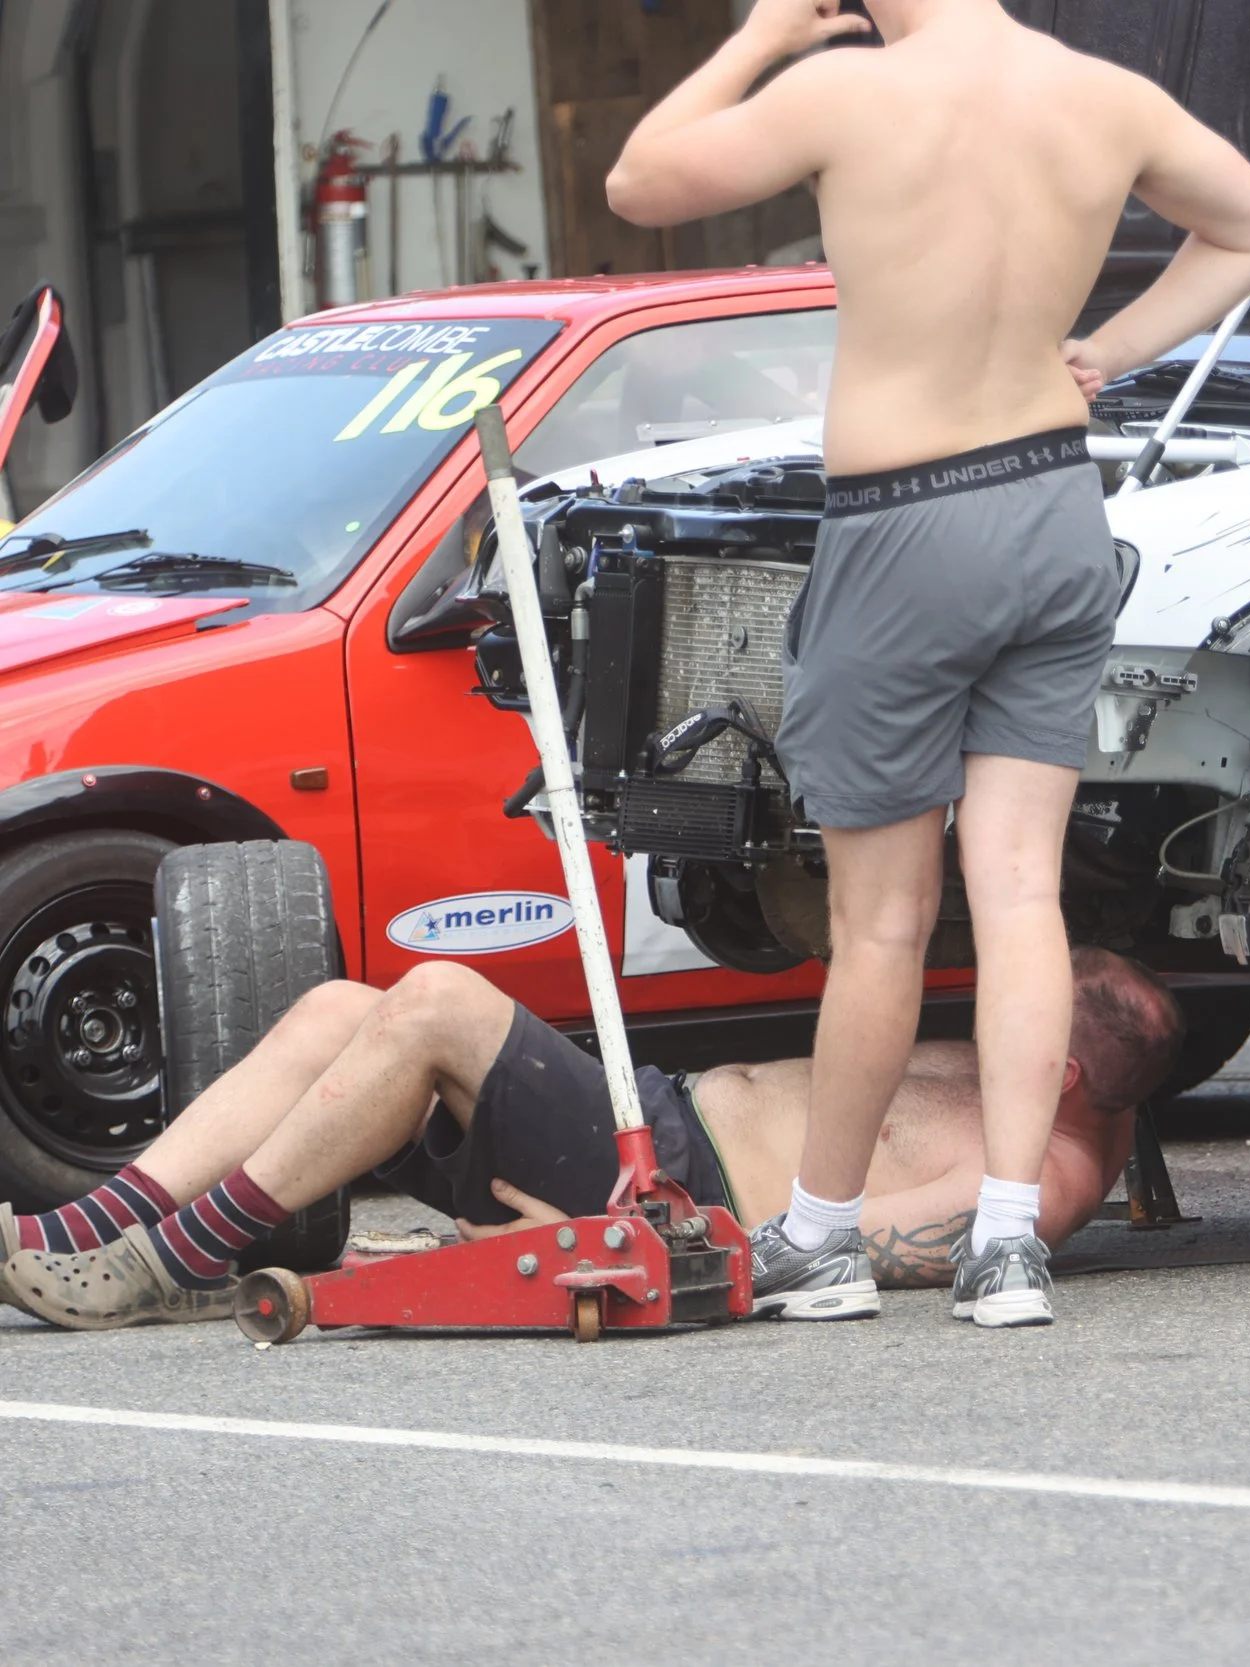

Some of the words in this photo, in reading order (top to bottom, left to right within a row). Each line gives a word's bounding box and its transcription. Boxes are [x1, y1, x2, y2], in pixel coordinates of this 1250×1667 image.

[351, 353, 431, 373] CLU
[333, 349, 522, 442] 116
[930, 455, 1023, 489] UNDER
[445, 901, 553, 928] merlin
